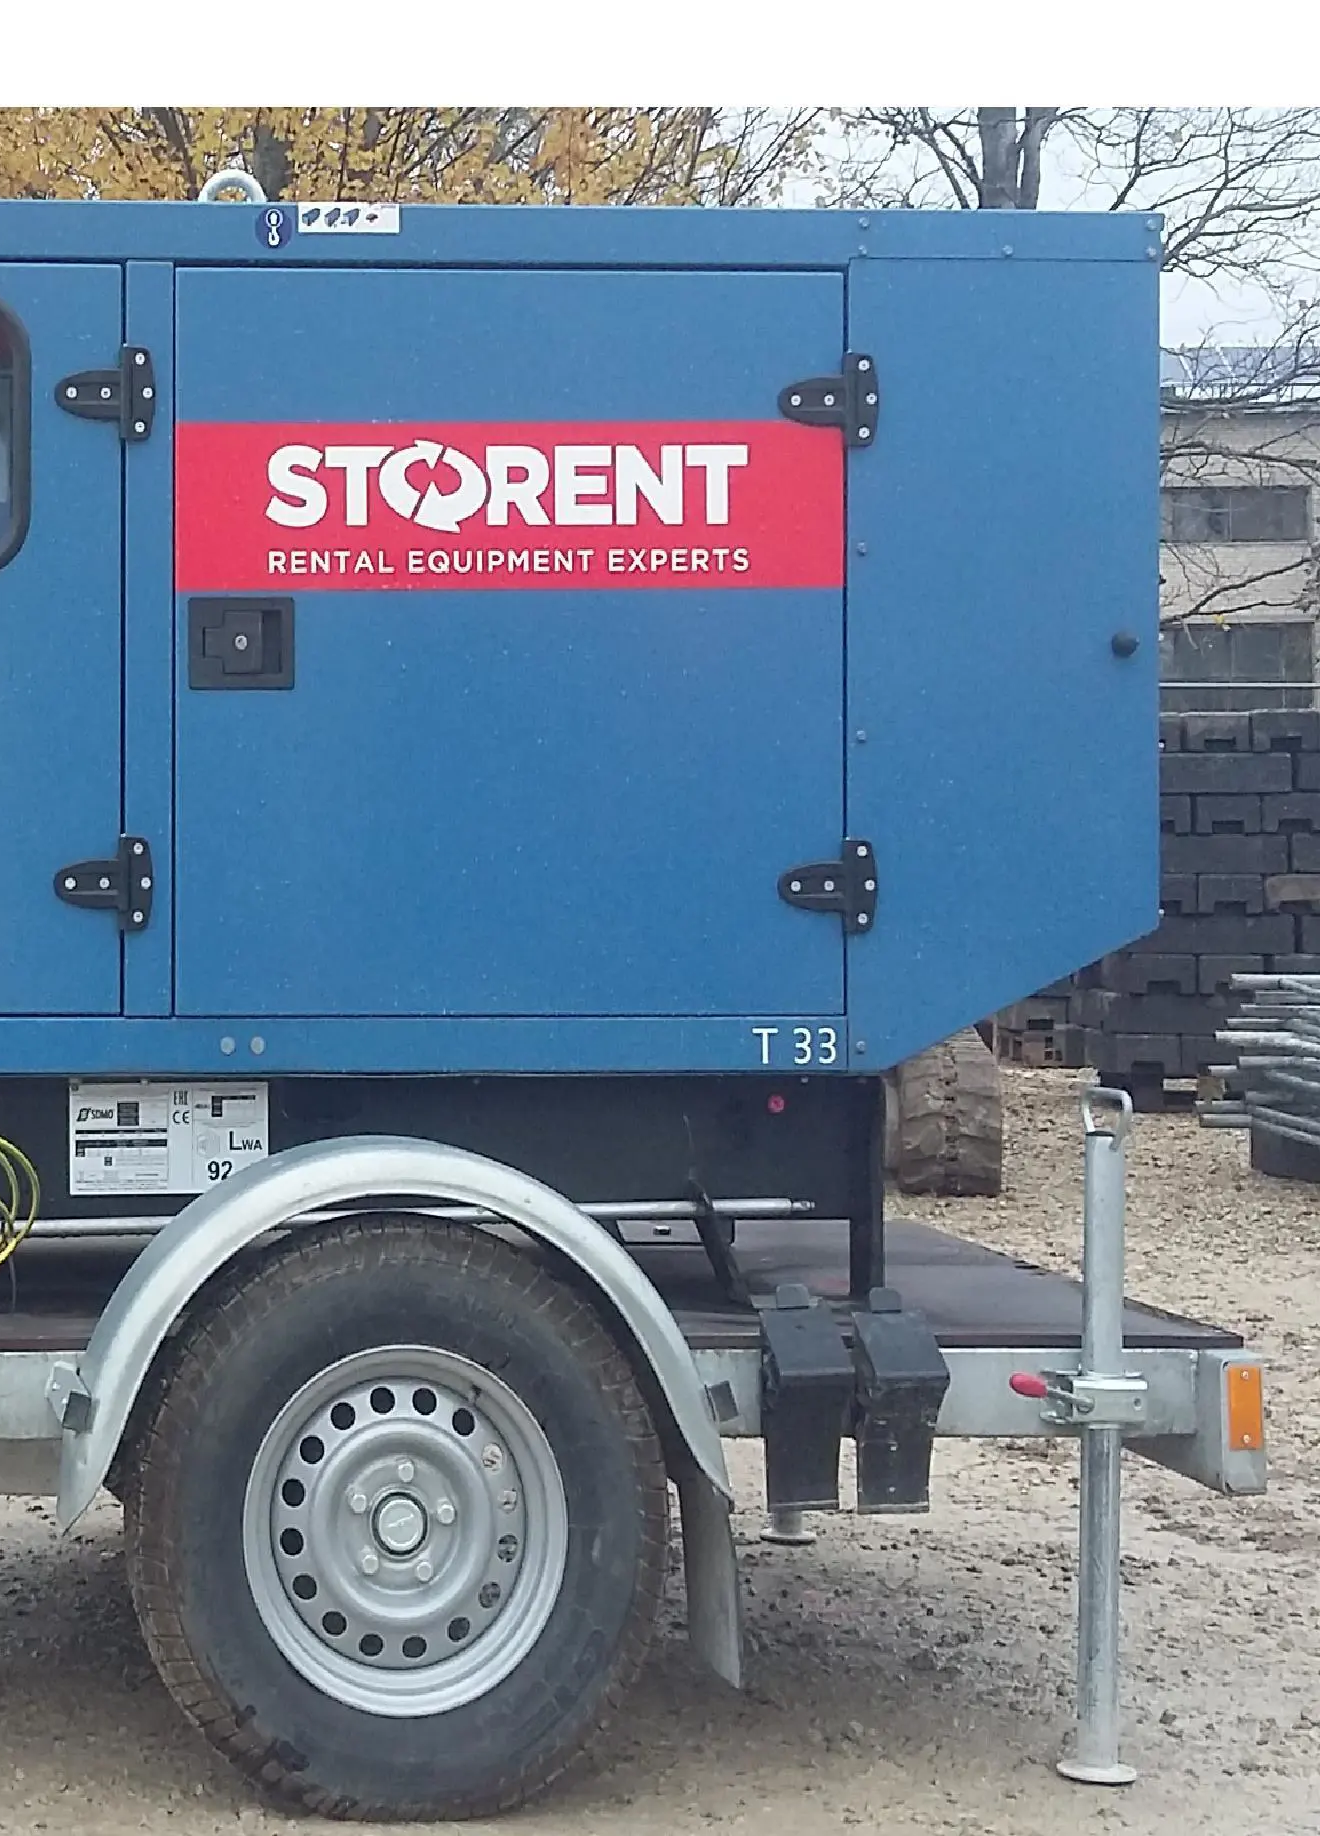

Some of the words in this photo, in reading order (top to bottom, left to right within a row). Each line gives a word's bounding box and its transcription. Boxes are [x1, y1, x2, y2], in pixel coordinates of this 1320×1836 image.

[266, 439, 748, 534] STORENT
[267, 550, 395, 575] RENTAL
[408, 549, 594, 574] EQUIPMENT
[607, 547, 750, 572] EXPERTS
[752, 1027, 779, 1065] T
[792, 1027, 837, 1065] 33
[207, 1160, 233, 1181] 92
